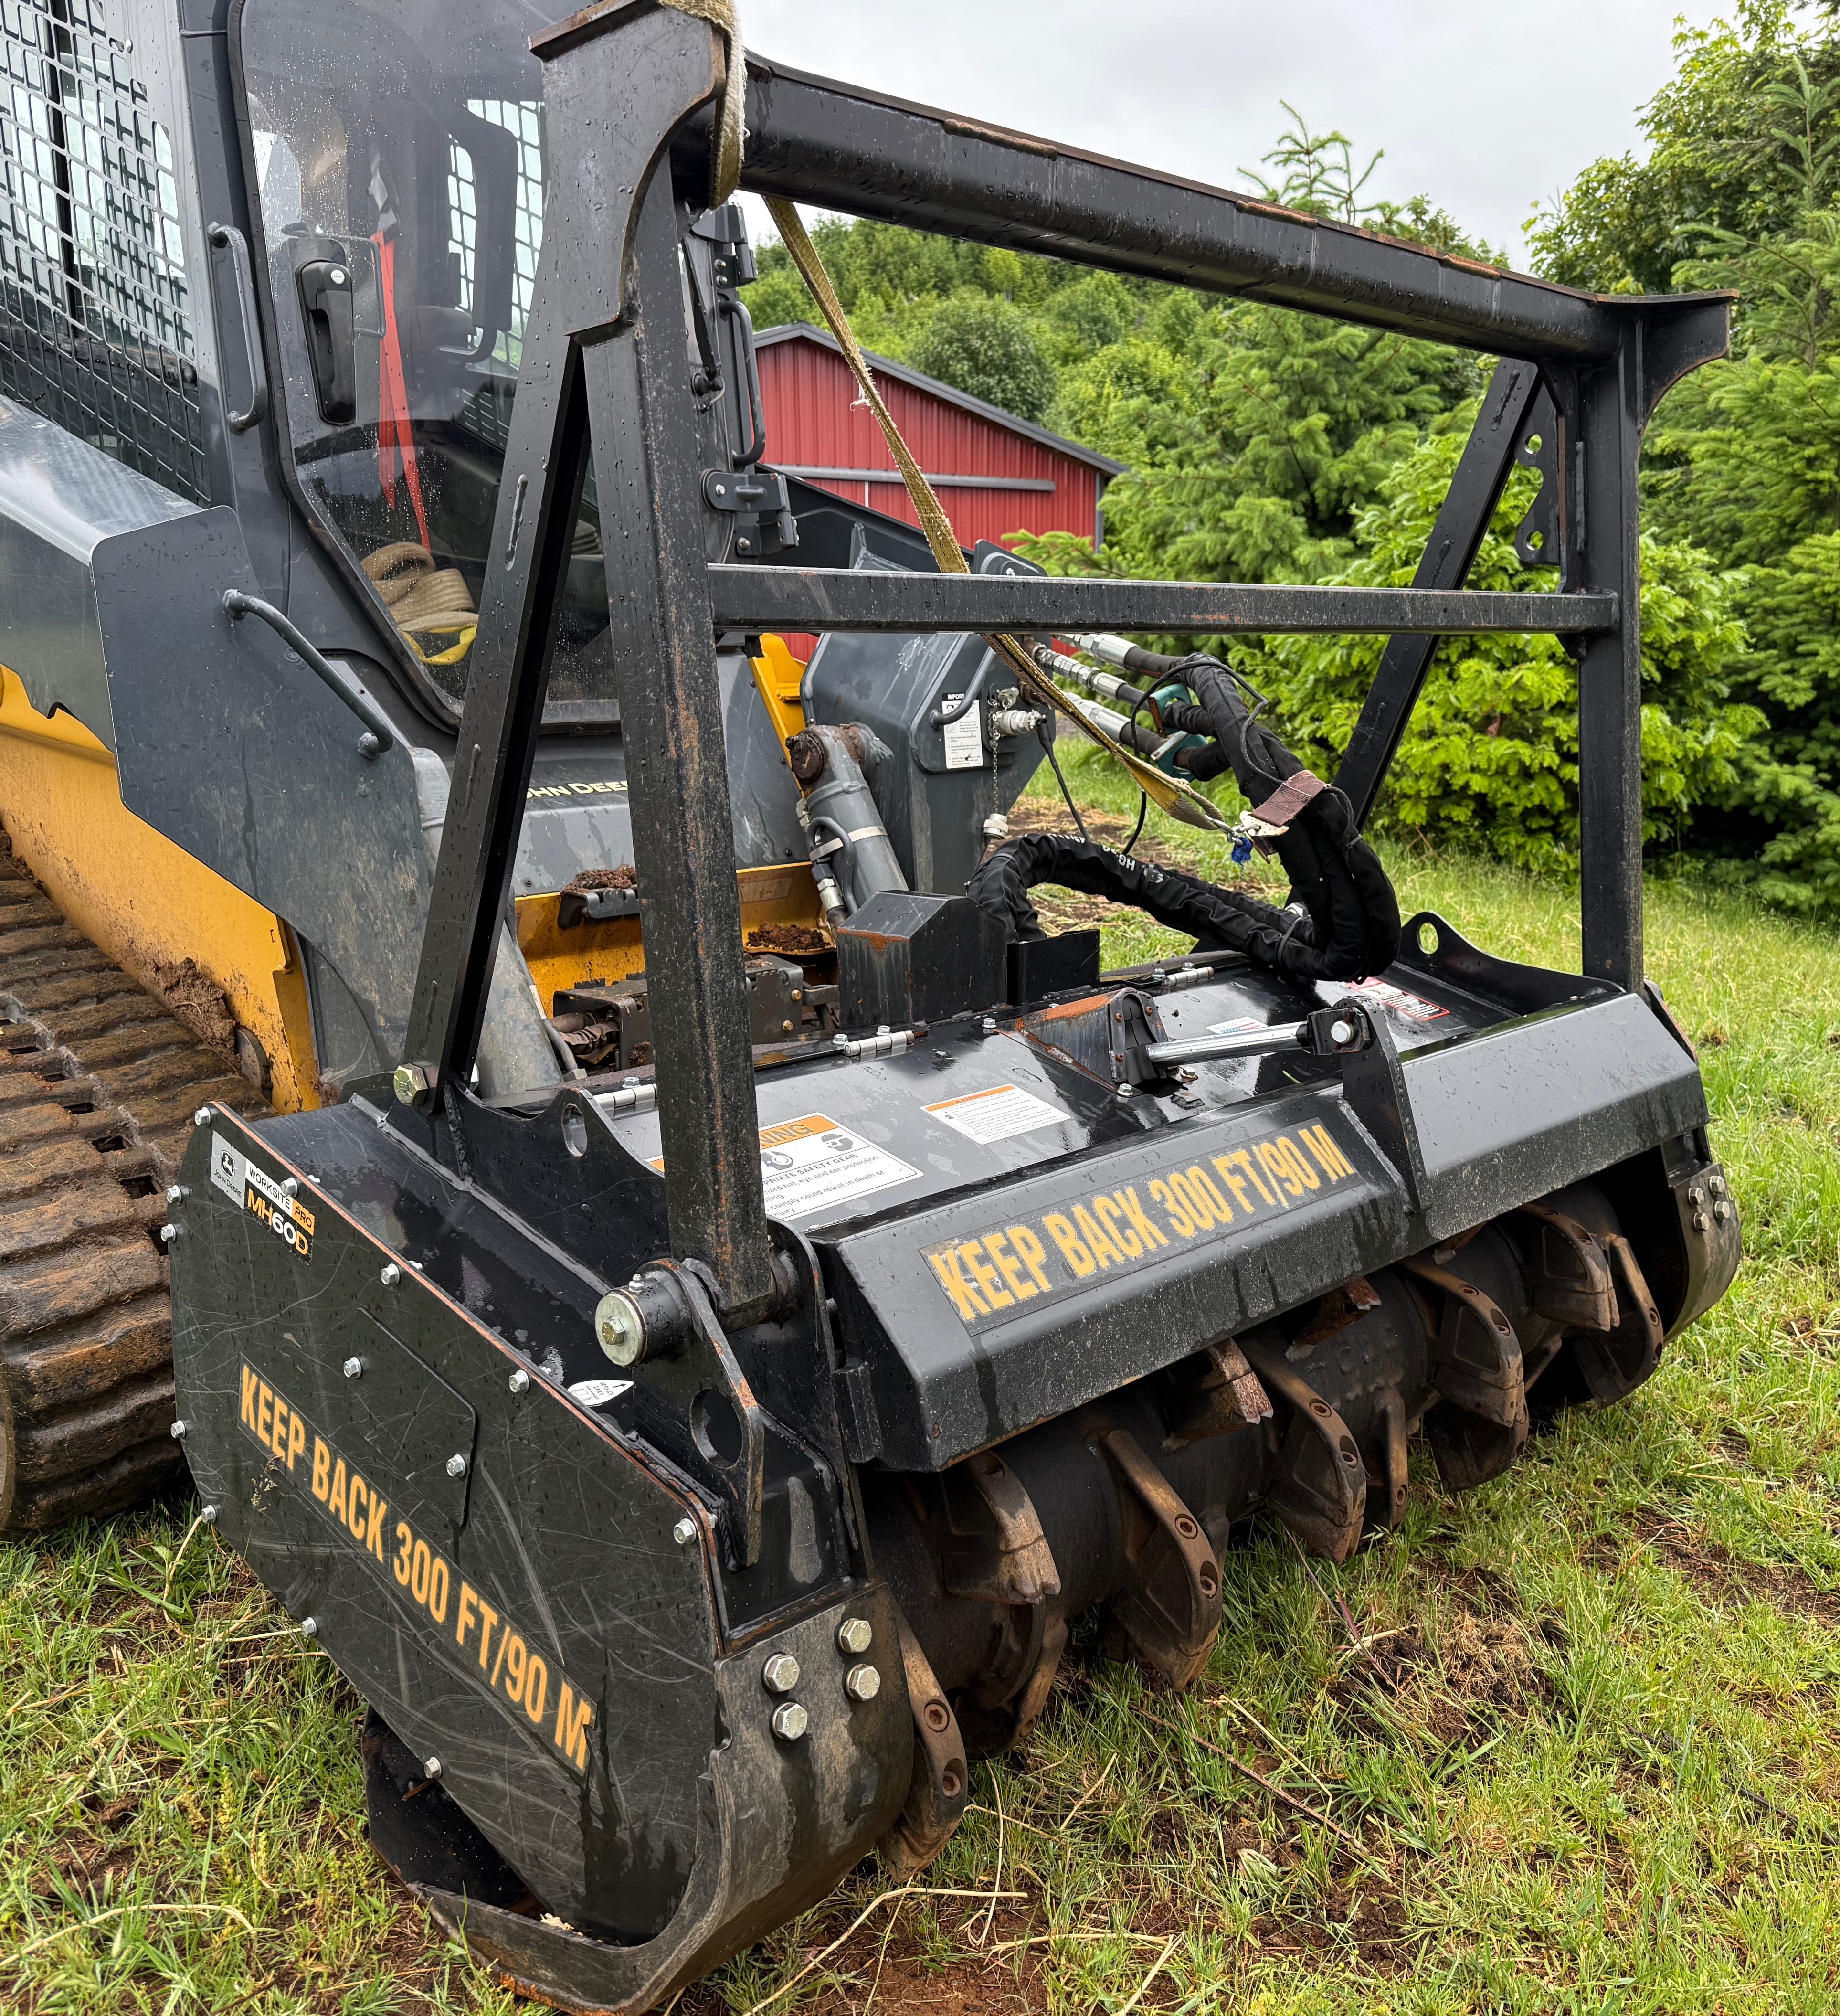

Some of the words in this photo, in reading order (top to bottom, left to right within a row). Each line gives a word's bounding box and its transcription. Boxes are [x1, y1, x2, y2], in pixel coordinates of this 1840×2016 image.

[759, 1124, 814, 1146] NING
[214, 1169, 226, 1185] JOHN
[763, 1172, 797, 1185] PRIATE
[797, 1161, 831, 1174] SAFETY
[833, 1154, 858, 1163] GEAR
[843, 1156, 879, 1170] protection
[249, 1166, 290, 1210] WORKSITE
[295, 1205, 312, 1228] PRO
[771, 1198, 800, 1210] comply
[800, 1190, 823, 1199] could
[823, 1182, 846, 1193] result
[855, 1174, 876, 1182] death
[248, 1188, 308, 1255] MH60D
[774, 1208, 797, 1217] njury.
[929, 1225, 1053, 1320] KEEP
[1044, 1187, 1169, 1277] BACK
[1149, 1166, 1234, 1238] 300
[1212, 1136, 1322, 1209] FT/90
[1299, 1124, 1355, 1182] M
[241, 1365, 306, 1472] KEEP
[311, 1436, 389, 1563] BACK
[393, 1523, 449, 1624] 300
[456, 1581, 547, 1723] FT/90
[555, 1682, 591, 1770] M
